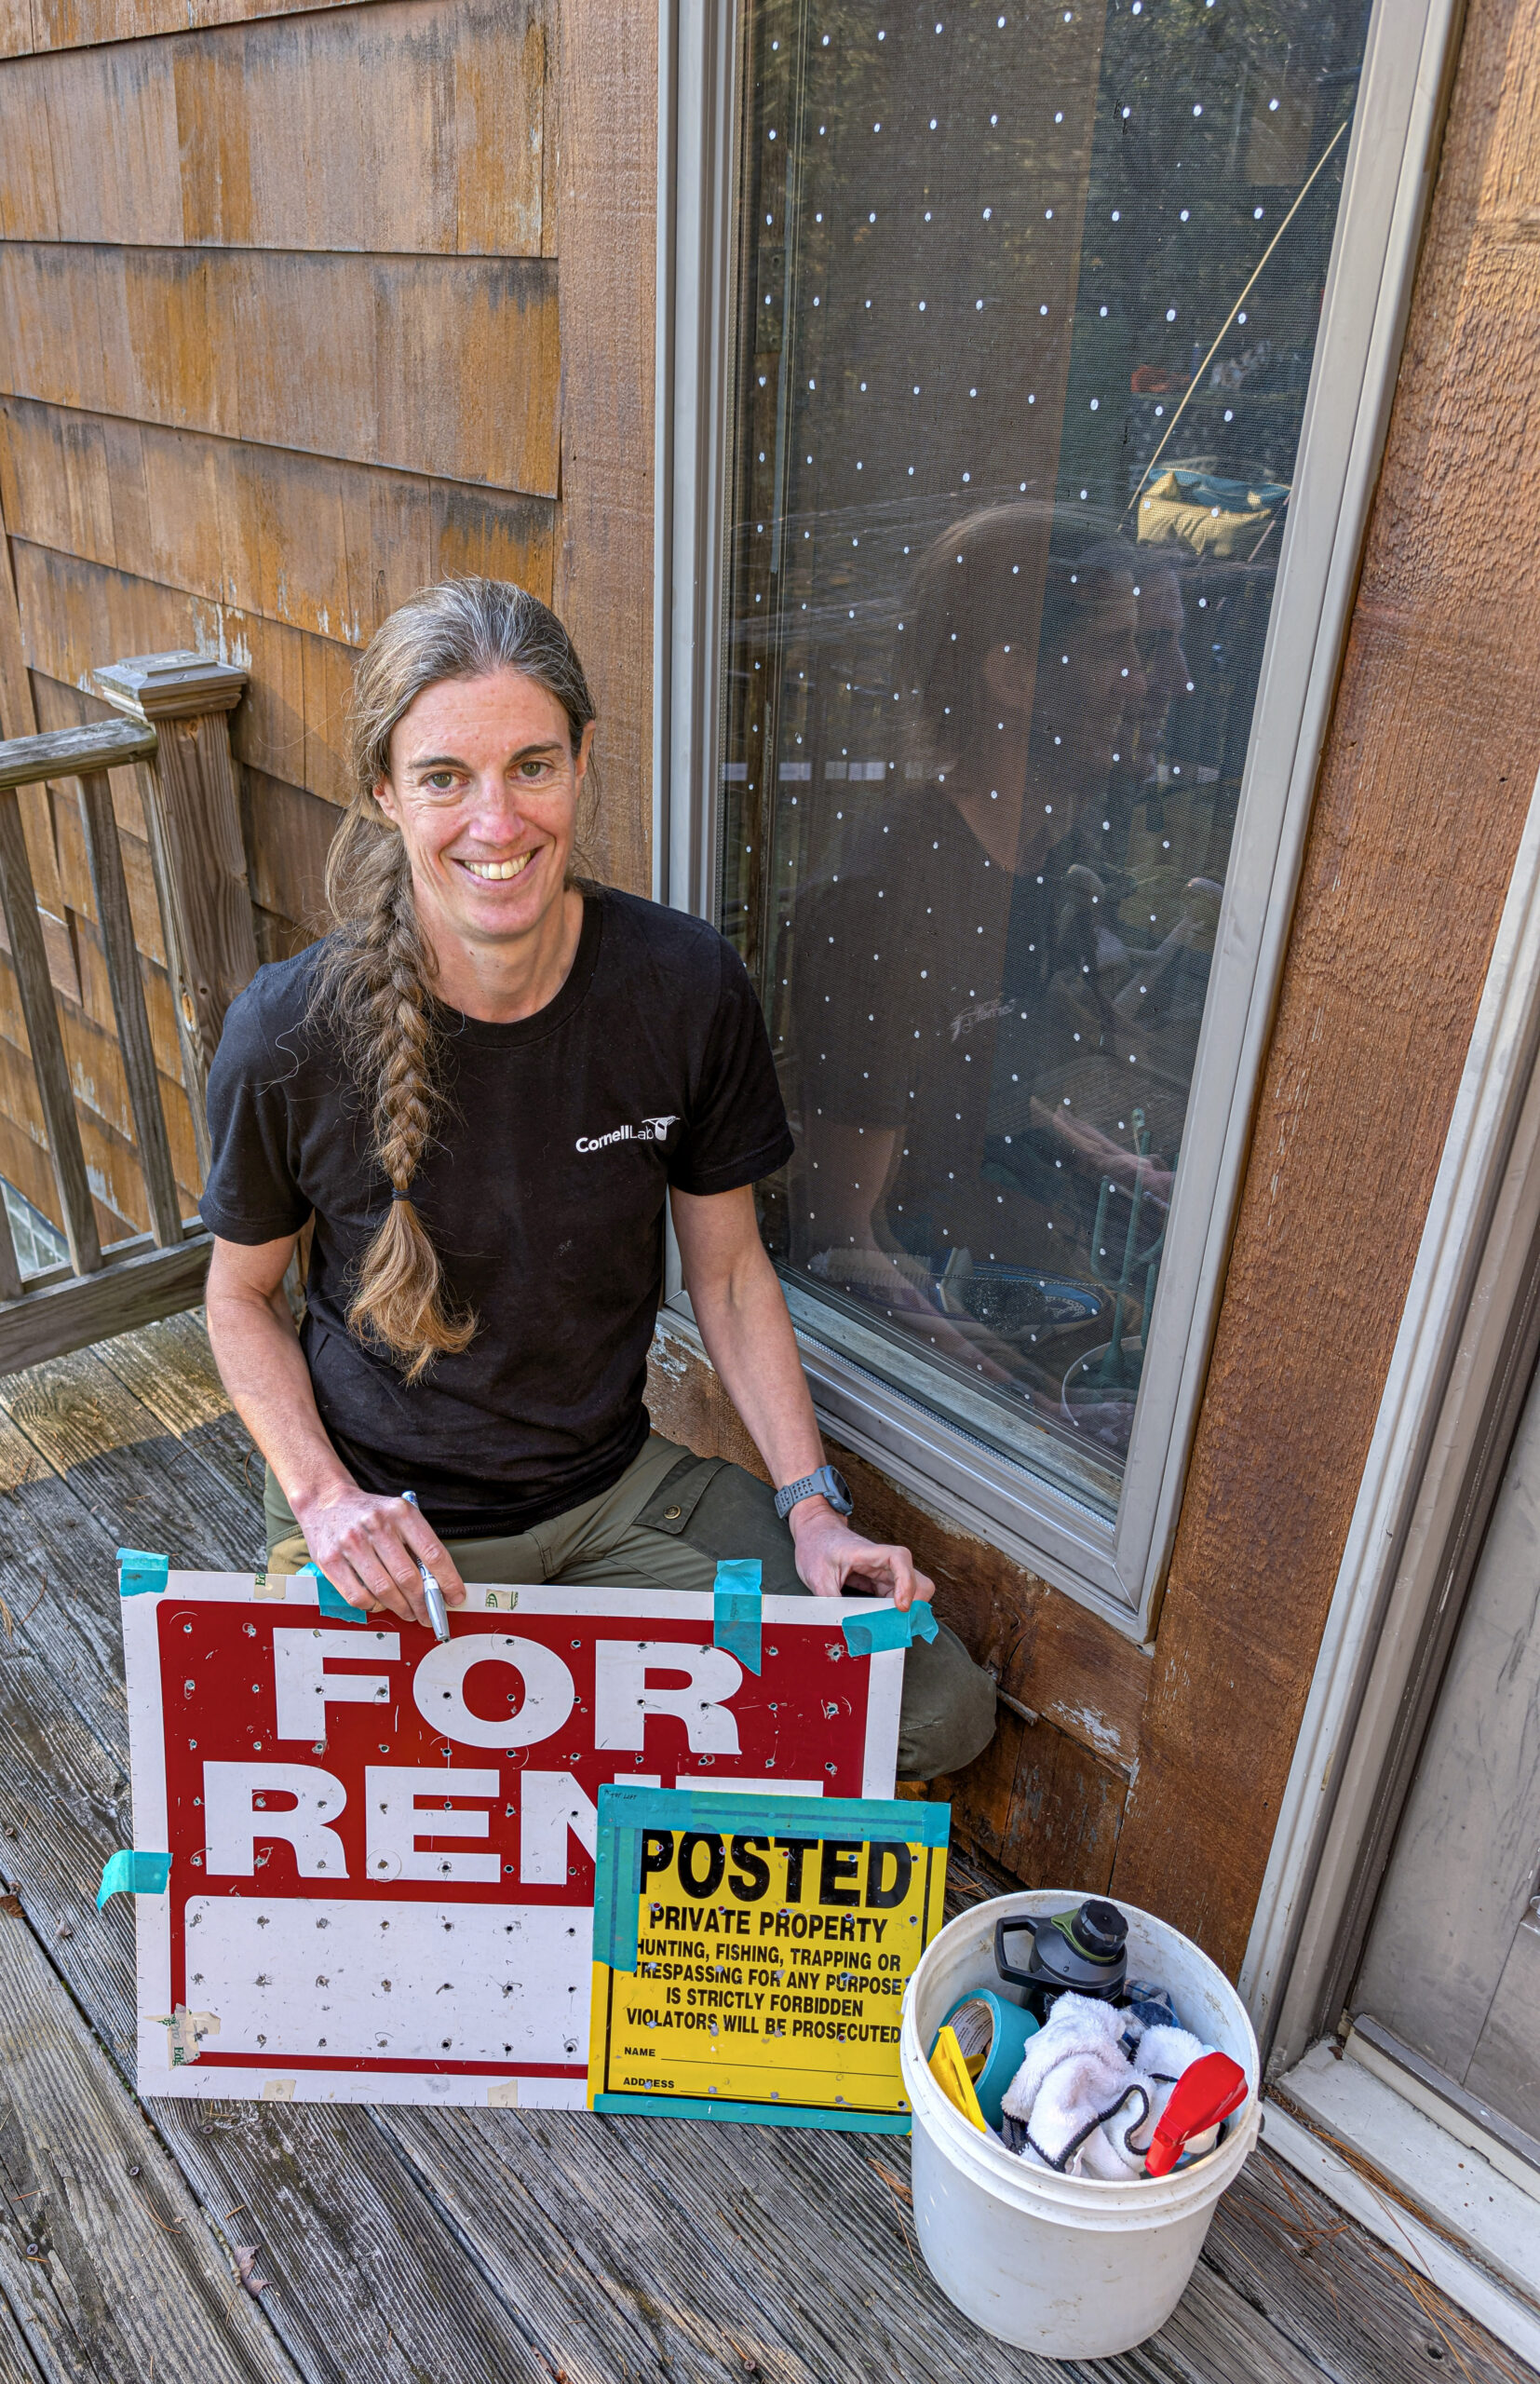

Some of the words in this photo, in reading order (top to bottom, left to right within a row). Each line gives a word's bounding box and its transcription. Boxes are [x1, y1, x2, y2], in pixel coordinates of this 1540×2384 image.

[273, 1627, 743, 1755] FOR
[203, 1761, 823, 1885] REN
[633, 1822, 912, 1909] POSTED
[650, 1906, 750, 1935] PRIVATE
[760, 1912, 888, 1944] PROPERTY
[716, 1944, 783, 1967] FISHING,
[790, 1948, 871, 1970] TRAPPING
[878, 1954, 900, 1971] OR
[633, 1962, 743, 1984] TRESPASSING
[749, 1969, 781, 1987] FOR
[786, 1971, 819, 1990] ANY
[826, 1974, 902, 1996] PURPOSE
[667, 1987, 681, 2004] IS
[687, 1988, 764, 2011] STRICTLY
[770, 1995, 863, 2017] FORBIDDEN
[627, 2008, 718, 2030] VIOLATORS
[723, 2014, 759, 2034] WILL
[765, 2018, 787, 2036] BE
[792, 2020, 900, 2043] PROSECUTED
[625, 2047, 655, 2057] NAME
[623, 2078, 675, 2089] ADDRESS
